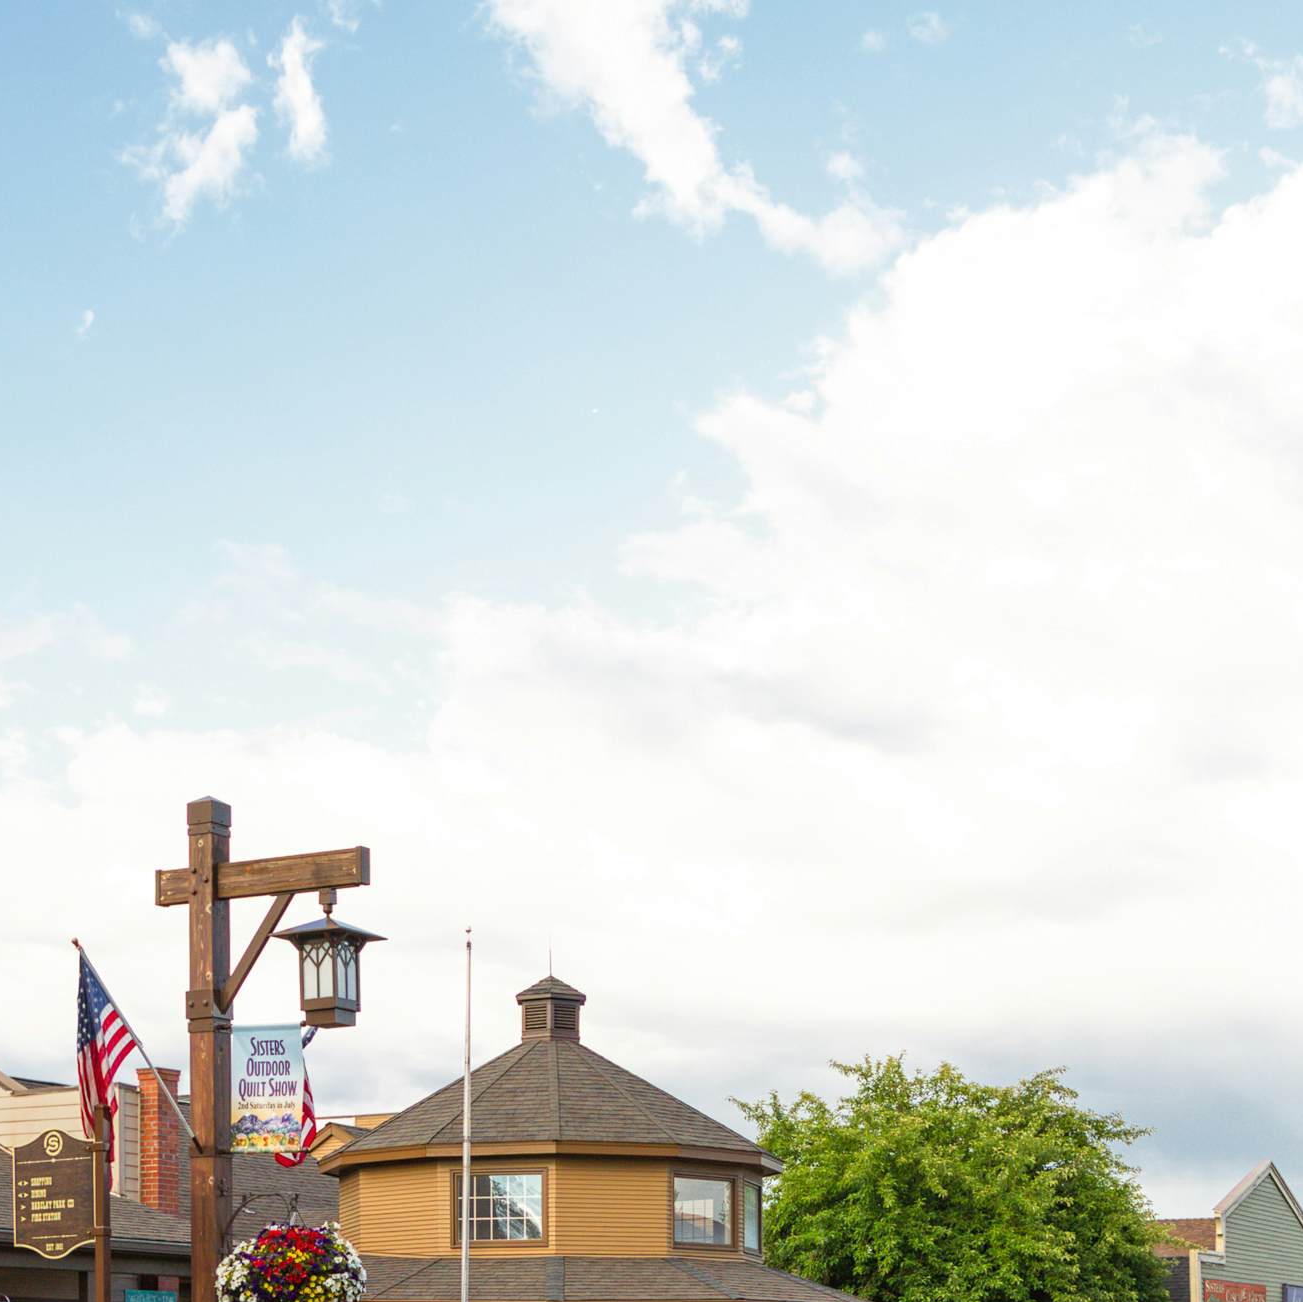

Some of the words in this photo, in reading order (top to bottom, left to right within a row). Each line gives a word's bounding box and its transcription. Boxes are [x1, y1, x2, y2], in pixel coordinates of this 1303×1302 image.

[250, 1036, 286, 1057] SISTERS
[246, 1057, 291, 1077] OUTDOOR
[239, 1078, 267, 1101] QUILT
[268, 1077, 298, 1097] SHOW
[250, 1100, 276, 1112] Saturday
